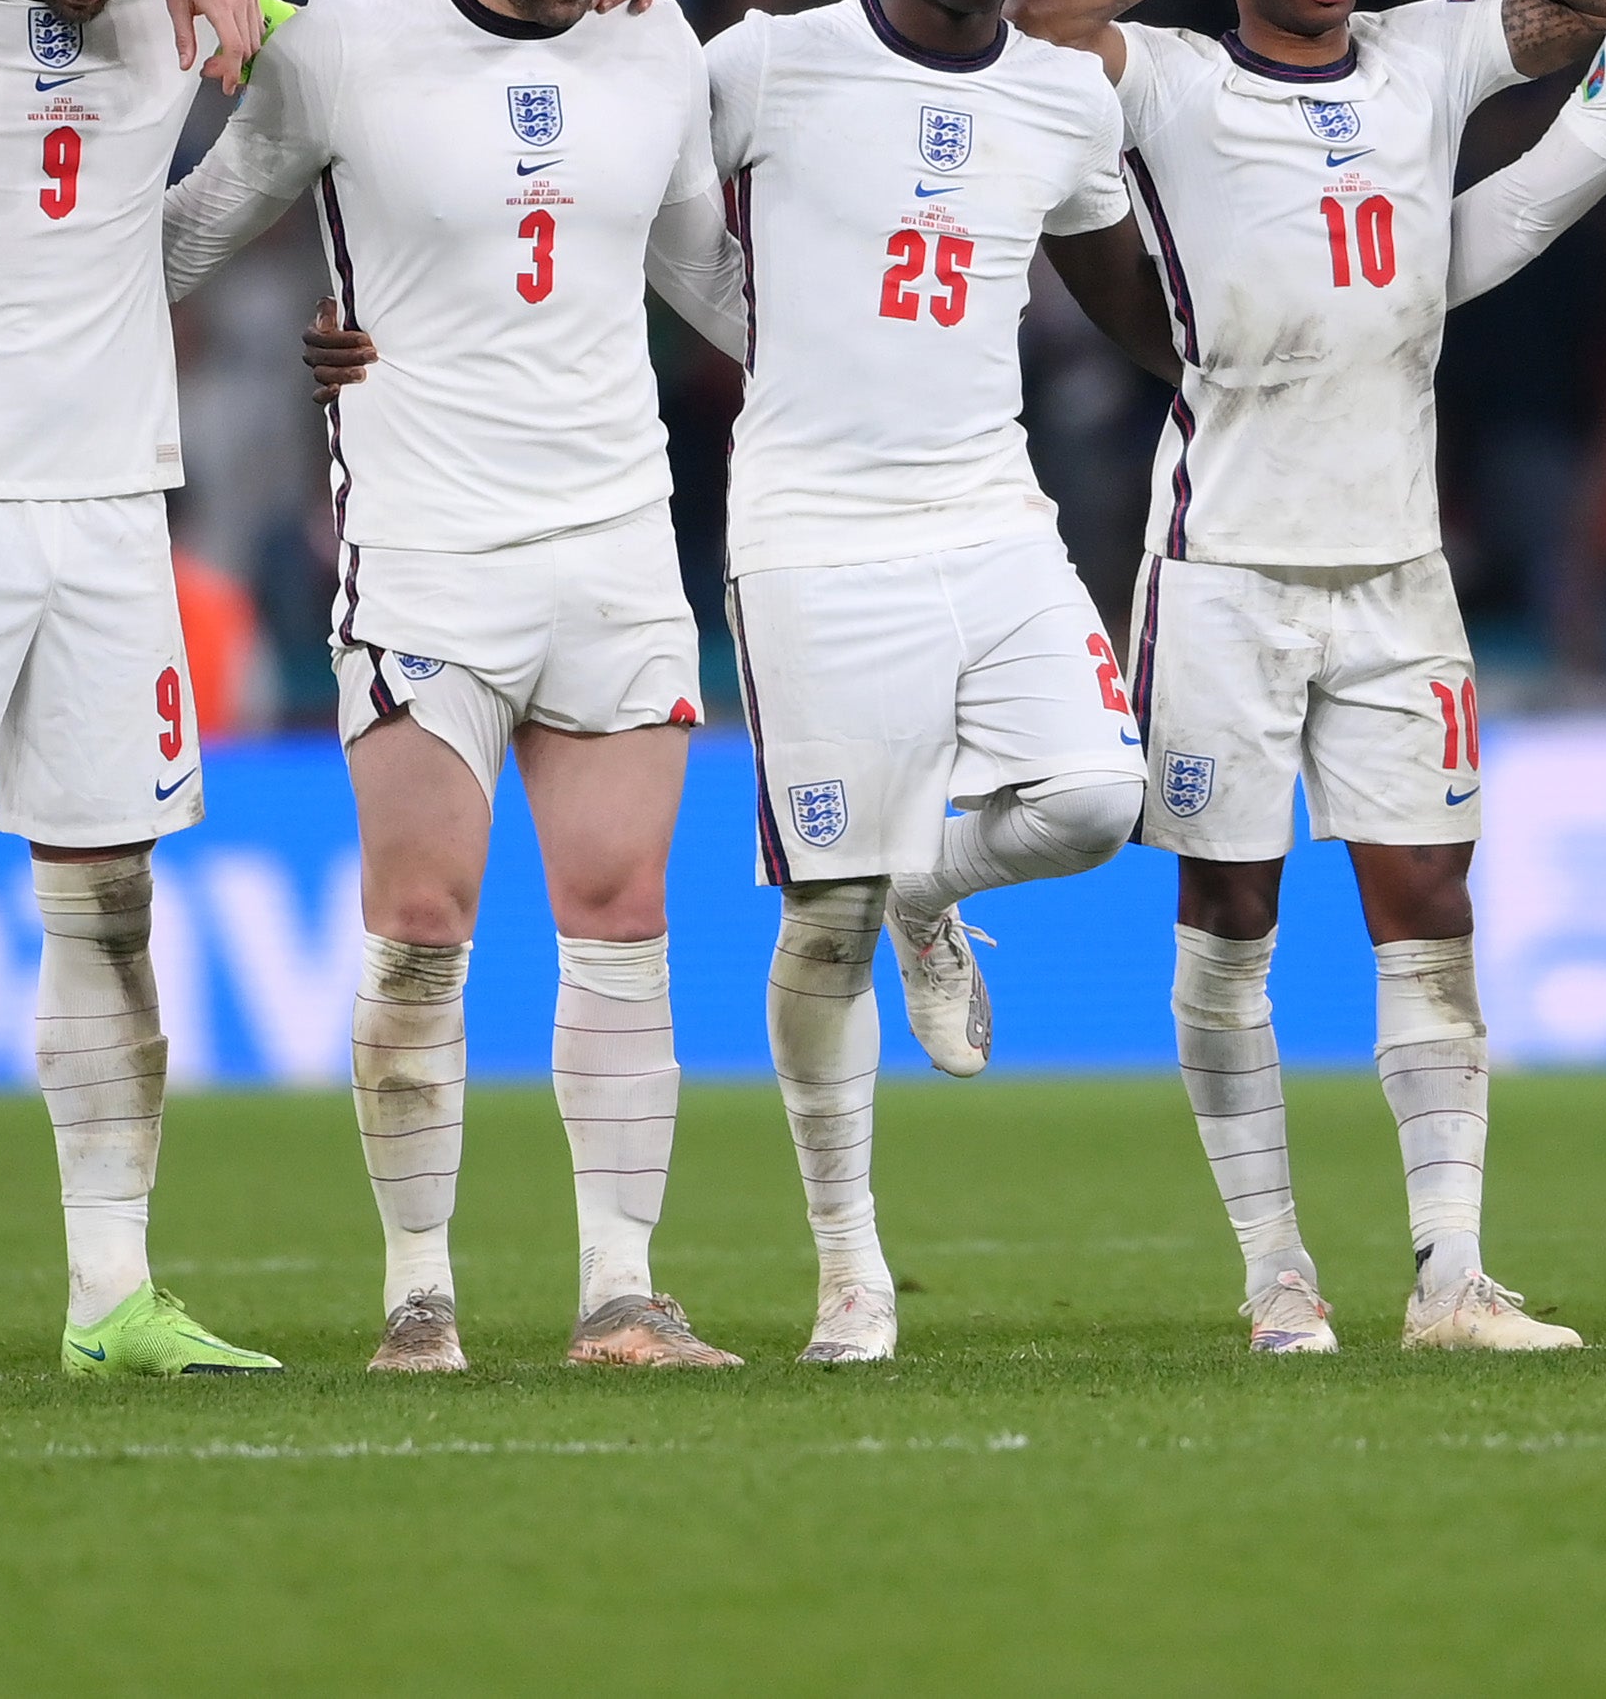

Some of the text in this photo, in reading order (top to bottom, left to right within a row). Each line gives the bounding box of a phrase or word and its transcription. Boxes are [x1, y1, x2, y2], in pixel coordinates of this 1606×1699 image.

[40, 127, 83, 220] 9
[517, 209, 556, 304] 3
[879, 229, 975, 327] 25
[1320, 194, 1397, 289] 10
[156, 666, 184, 762] 9
[1429, 679, 1481, 770] 10
